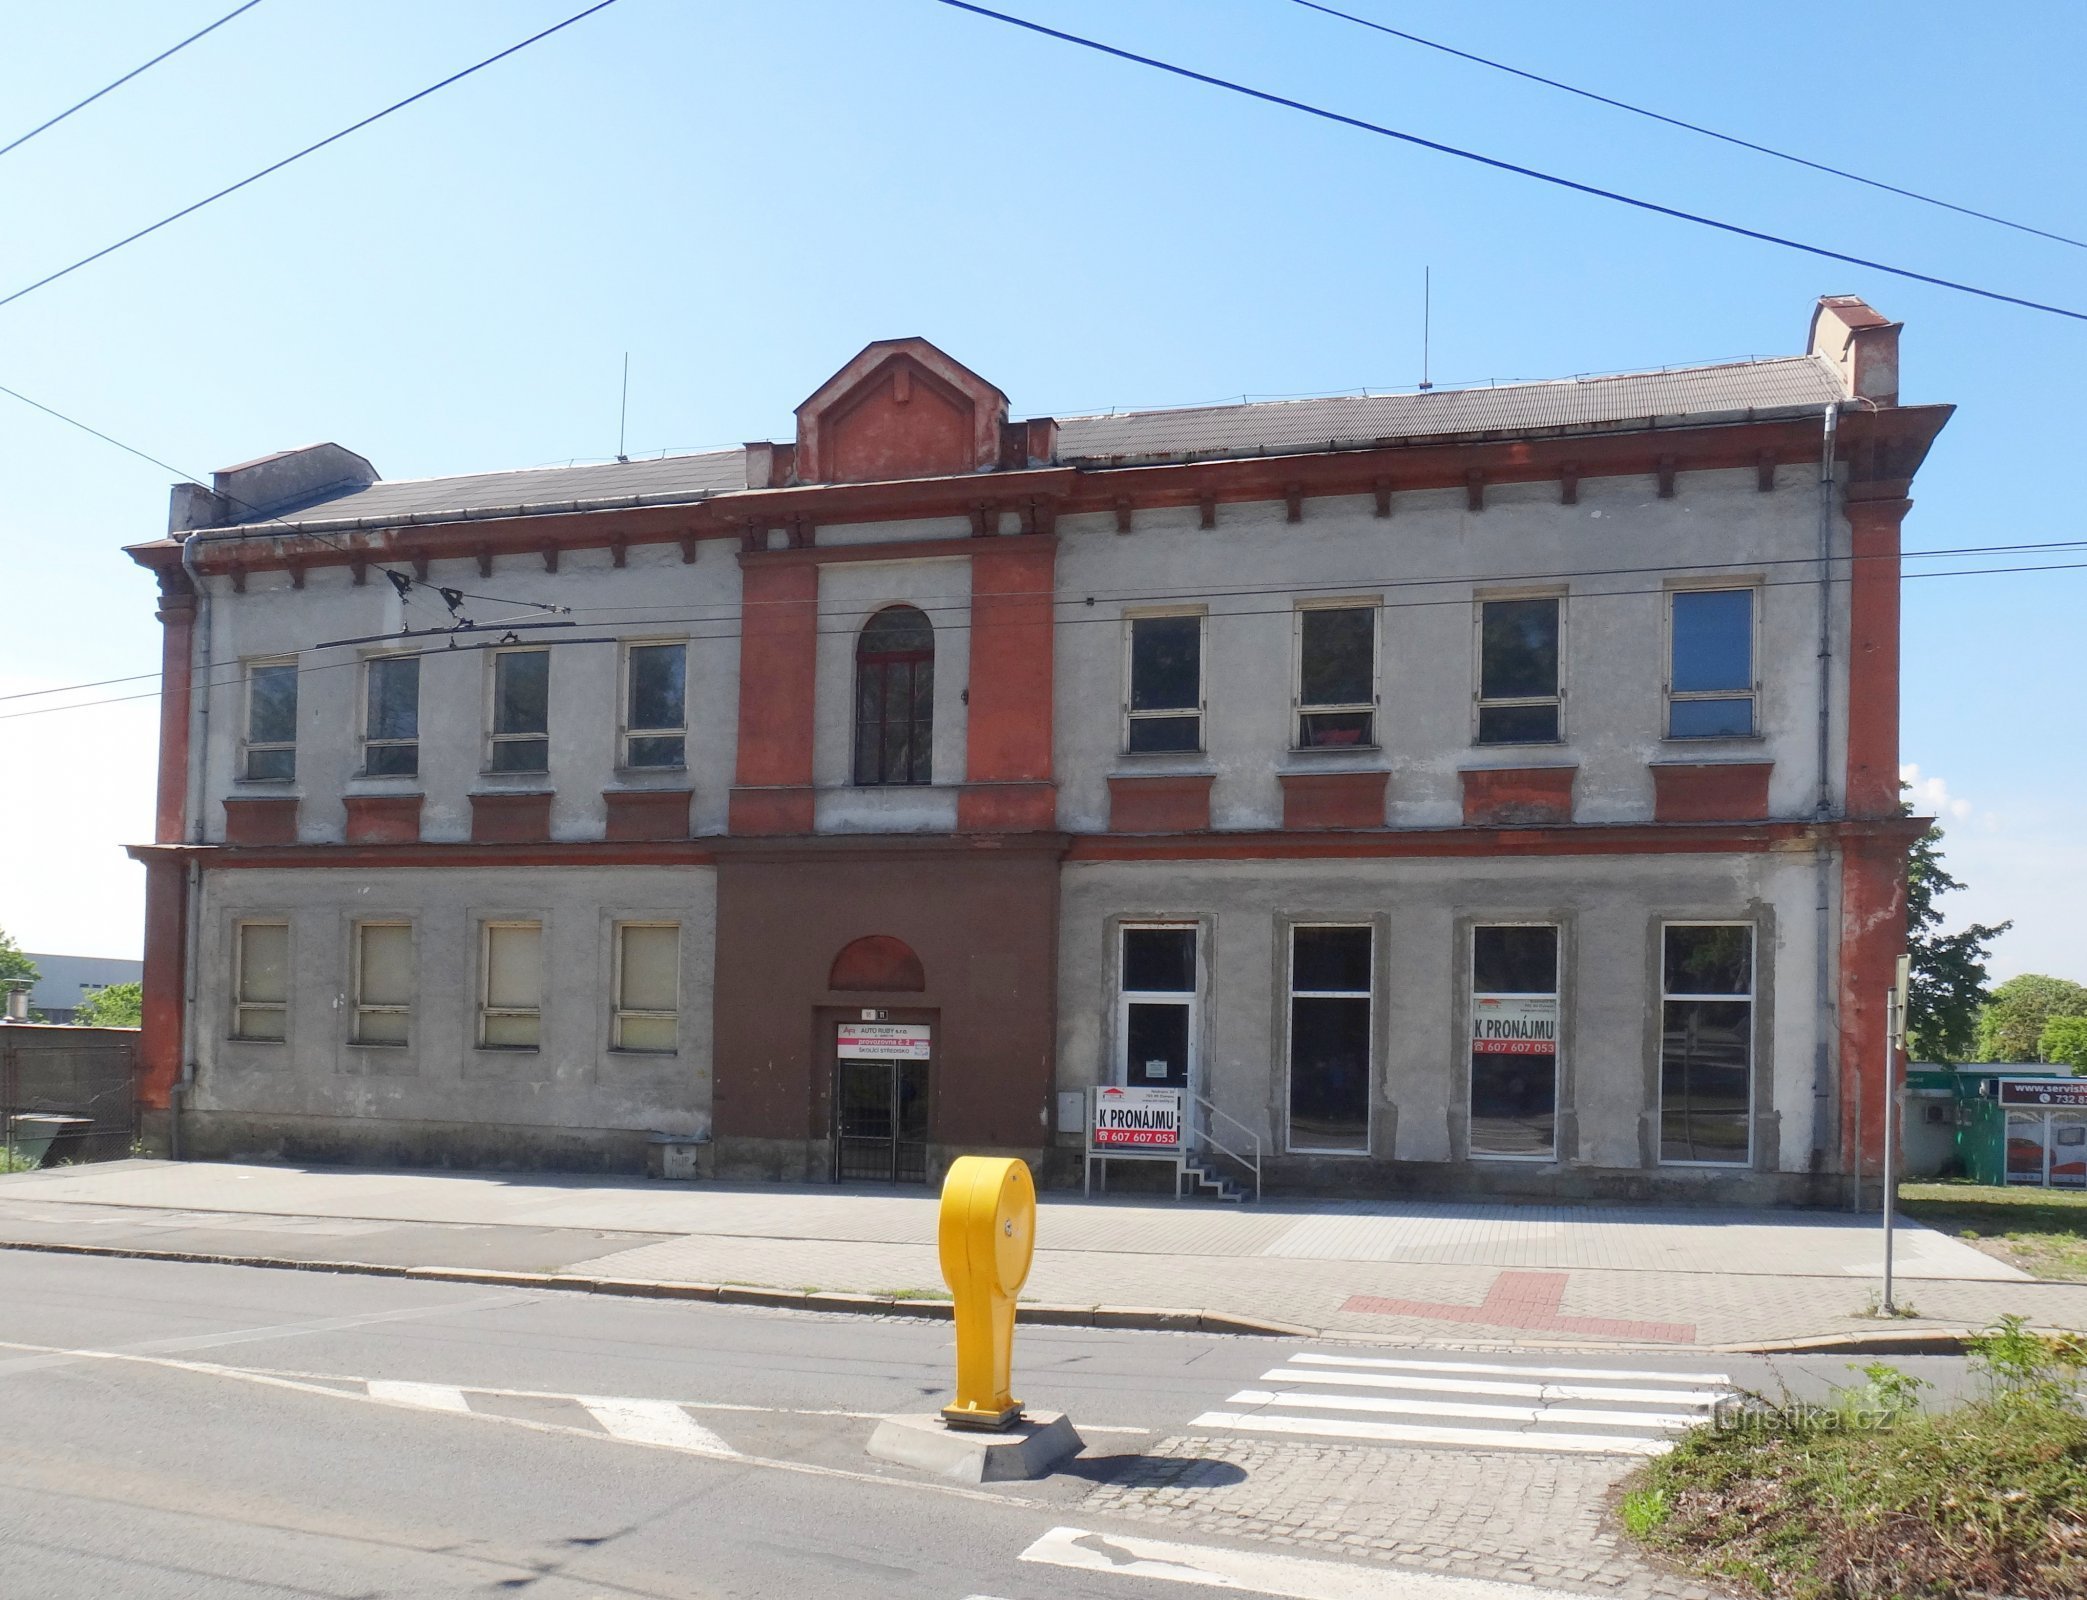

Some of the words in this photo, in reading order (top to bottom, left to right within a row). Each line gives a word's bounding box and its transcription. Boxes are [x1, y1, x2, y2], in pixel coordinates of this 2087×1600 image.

[1475, 1019, 1482, 1038] K
[1487, 1014, 1554, 1039] PRONÁJMU
[1487, 1043, 1507, 1052] 607
[1511, 1043, 1531, 1052] 607
[1534, 1043, 1554, 1053] 053
[2056, 1094, 2075, 1104] 732
[1100, 1109, 1106, 1127] K
[1110, 1105, 1174, 1129] PRONÁJMU
[1111, 1132, 1130, 1141] 607
[1133, 1133, 1153, 1142] 607
[1155, 1134, 1175, 1143] 053
